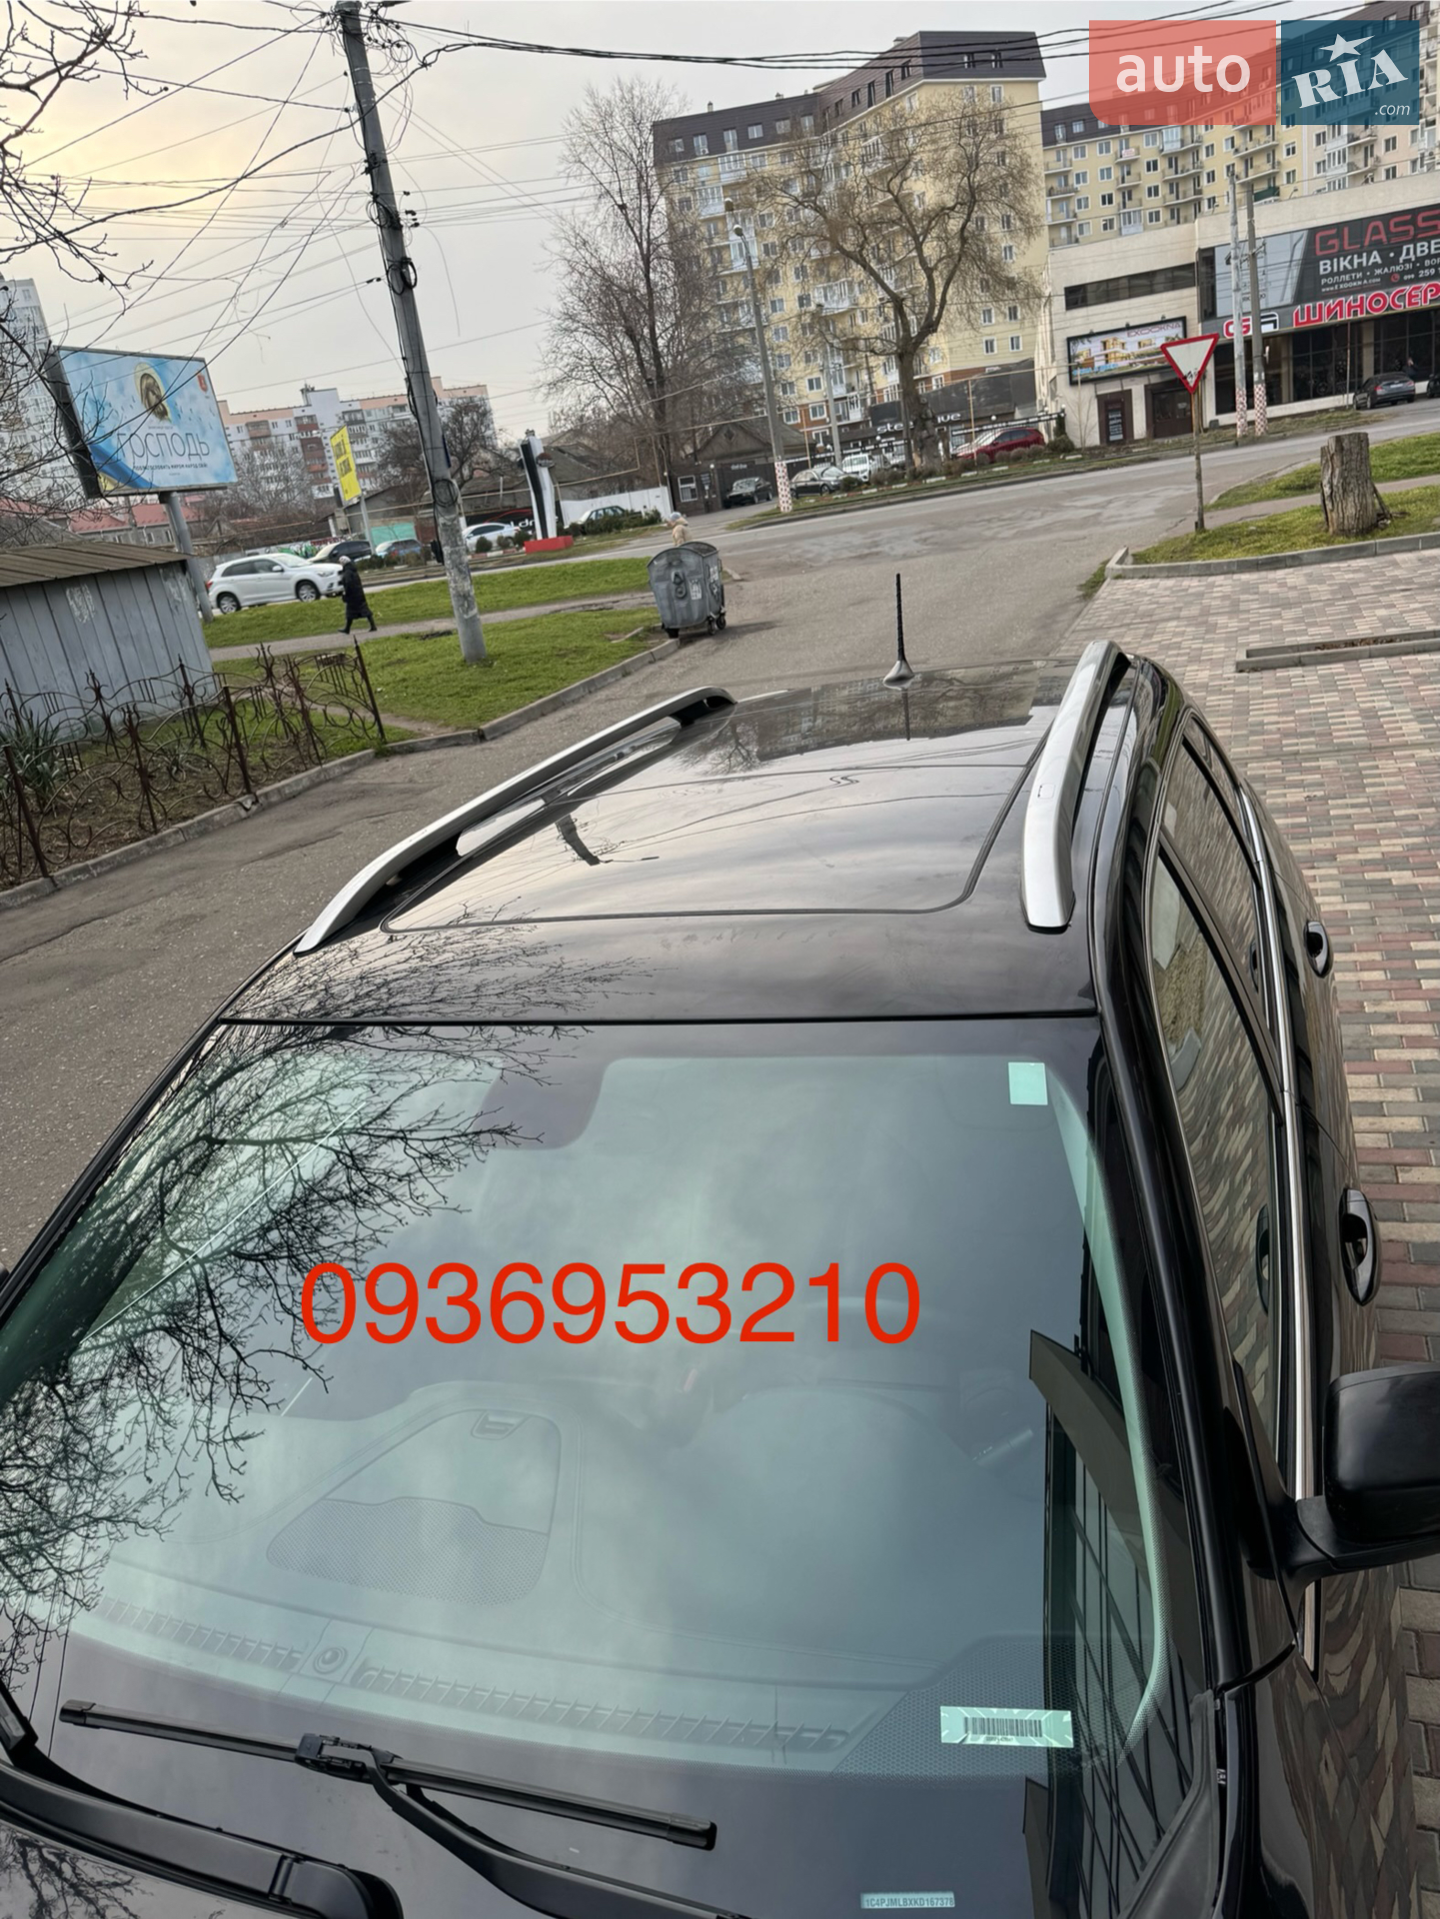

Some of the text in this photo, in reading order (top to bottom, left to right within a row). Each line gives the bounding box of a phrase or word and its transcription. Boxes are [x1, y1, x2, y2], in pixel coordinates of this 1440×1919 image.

[1315, 209, 1440, 256] GLASS
[1319, 250, 1382, 275] ВІКНА
[1321, 271, 1362, 285] РОЛЛЕТИ
[1374, 262, 1413, 276] ЖАЛЮЗІ
[1418, 267, 1436, 278] 259
[1293, 281, 1440, 328] ШИНОСЕР
[1126, 322, 1181, 338] EXOOKNA
[117, 432, 210, 460] ГОСПОДЬ
